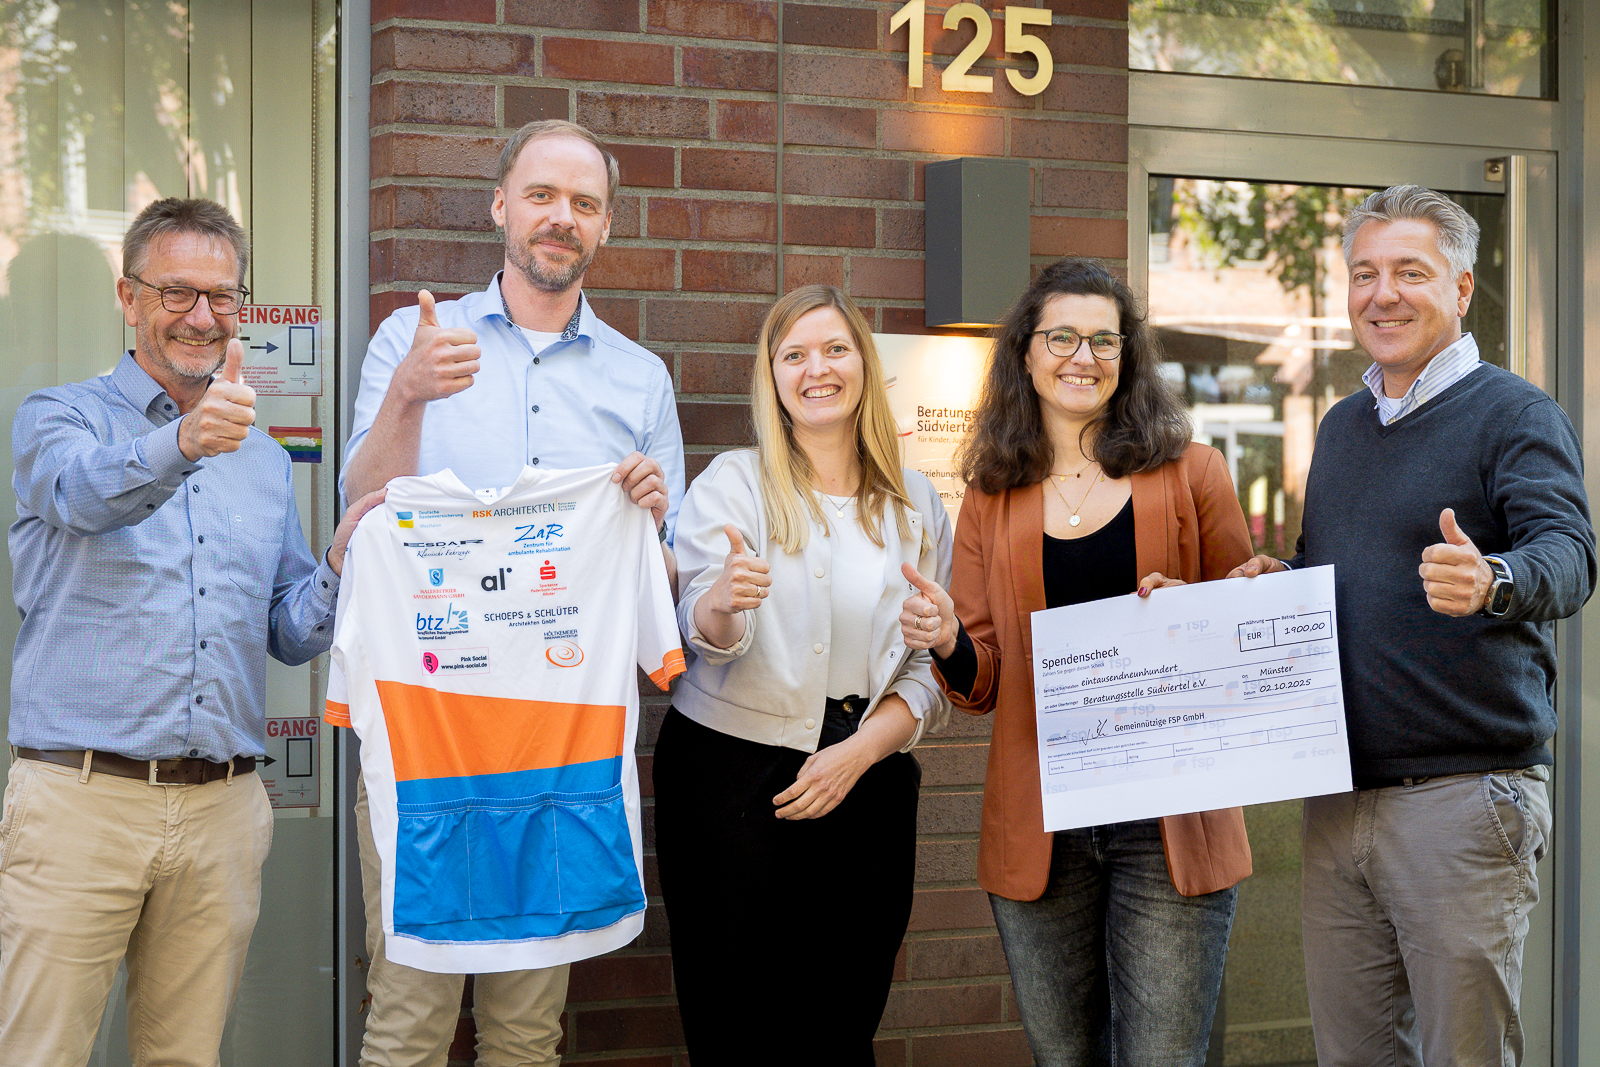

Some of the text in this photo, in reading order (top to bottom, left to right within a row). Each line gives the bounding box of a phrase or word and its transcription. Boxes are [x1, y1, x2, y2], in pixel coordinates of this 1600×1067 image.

[890, 0, 1054, 96] 125
[238, 307, 319, 325] EINGANG
[917, 405, 978, 422] Beratungs
[917, 420, 976, 433] Südvierte
[472, 509, 493, 518] RSK
[493, 502, 555, 517] ARCHITEKTEN
[514, 522, 564, 543] ZaR
[416, 612, 444, 631] btz
[484, 611, 524, 622] SCHOEPS
[534, 606, 579, 618] SCHLÜTER
[1247, 622, 1326, 640] EUR 1900,00
[441, 662, 487, 670] www.pink-social.de
[1042, 646, 1119, 670] Spendenscheck
[1081, 664, 1178, 687] eintausendneunhundert
[1259, 665, 1294, 677] Münster
[1083, 686, 1145, 706] Beratungsstelle
[1147, 680, 1190, 695] Südviertel
[1259, 678, 1312, 693] 02.10.2025
[266, 719, 317, 737] GANG
[1114, 712, 1205, 732] Gemeinnützige FSP GmbH
